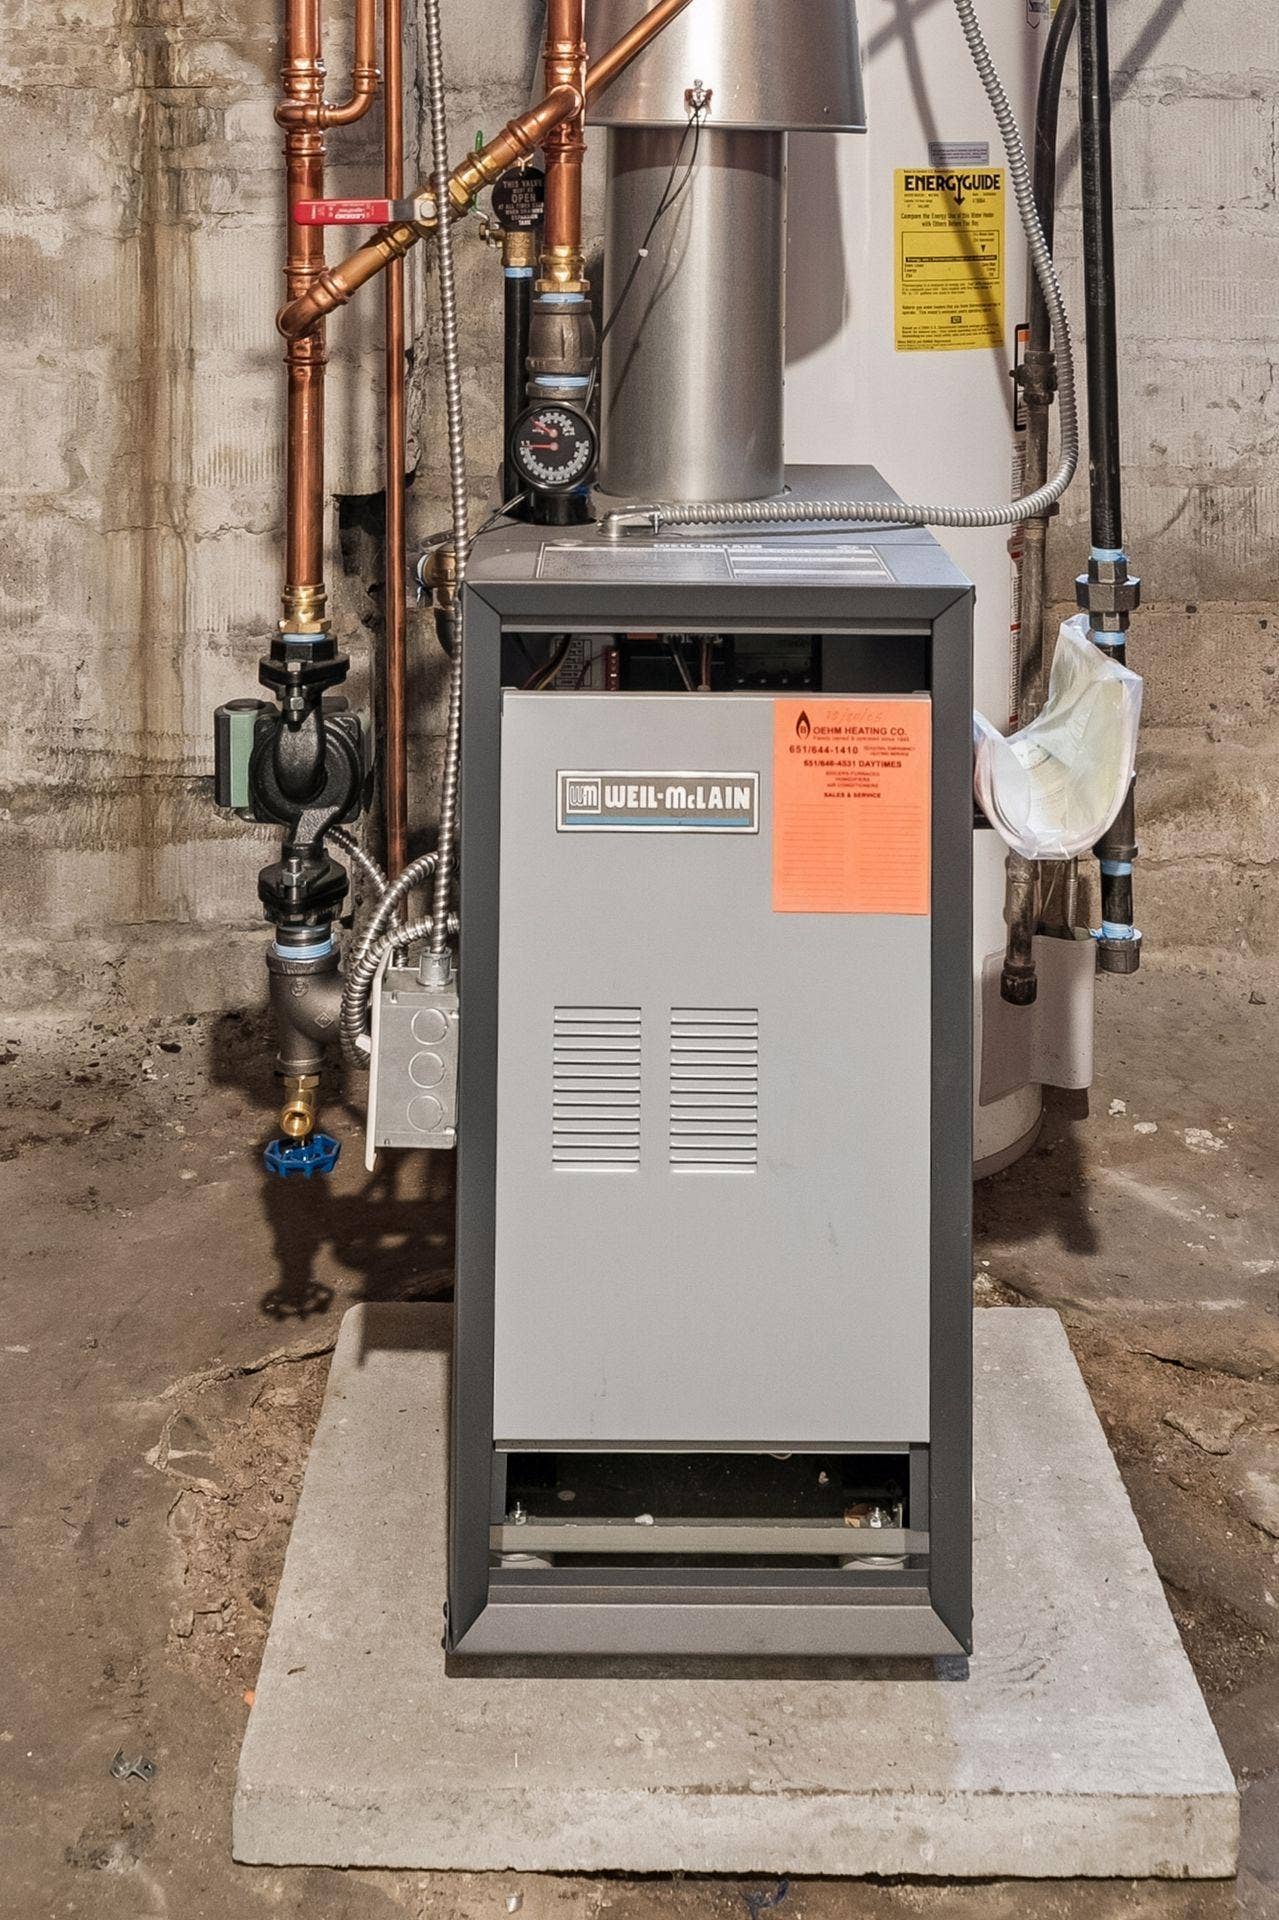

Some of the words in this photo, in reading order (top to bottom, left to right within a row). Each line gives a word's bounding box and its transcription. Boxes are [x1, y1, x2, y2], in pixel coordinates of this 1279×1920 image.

[904, 174, 1001, 192] ENERGYGUIDE
[511, 194, 536, 203] OPEN
[845, 727, 887, 736] HEATING
[890, 727, 907, 736] CO.
[789, 744, 859, 755] 651/644-1410
[858, 760, 902, 768] DAYTIMES
